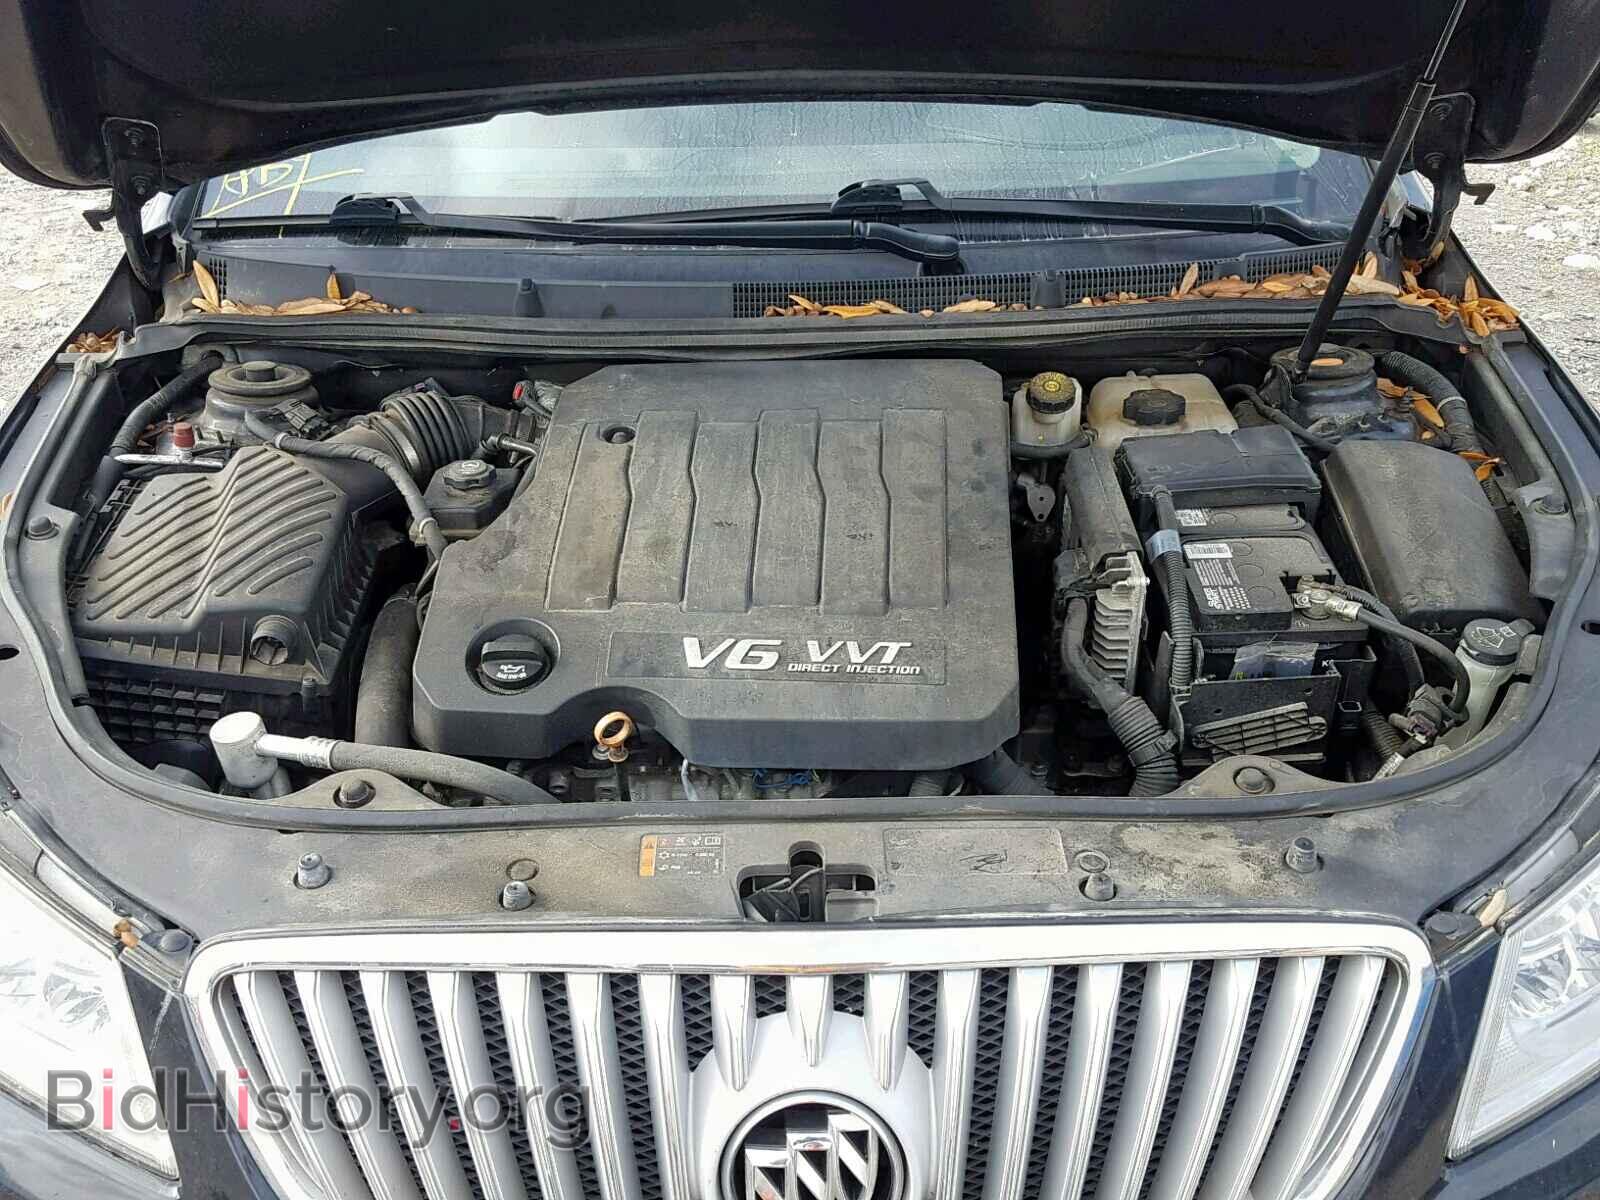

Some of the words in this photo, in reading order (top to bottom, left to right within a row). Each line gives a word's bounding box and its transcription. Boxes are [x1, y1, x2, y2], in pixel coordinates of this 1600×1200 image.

[683, 637, 782, 670] V6
[807, 640, 913, 664] VVT
[787, 663, 840, 673] DIRECT
[846, 664, 921, 675] INJECTION
